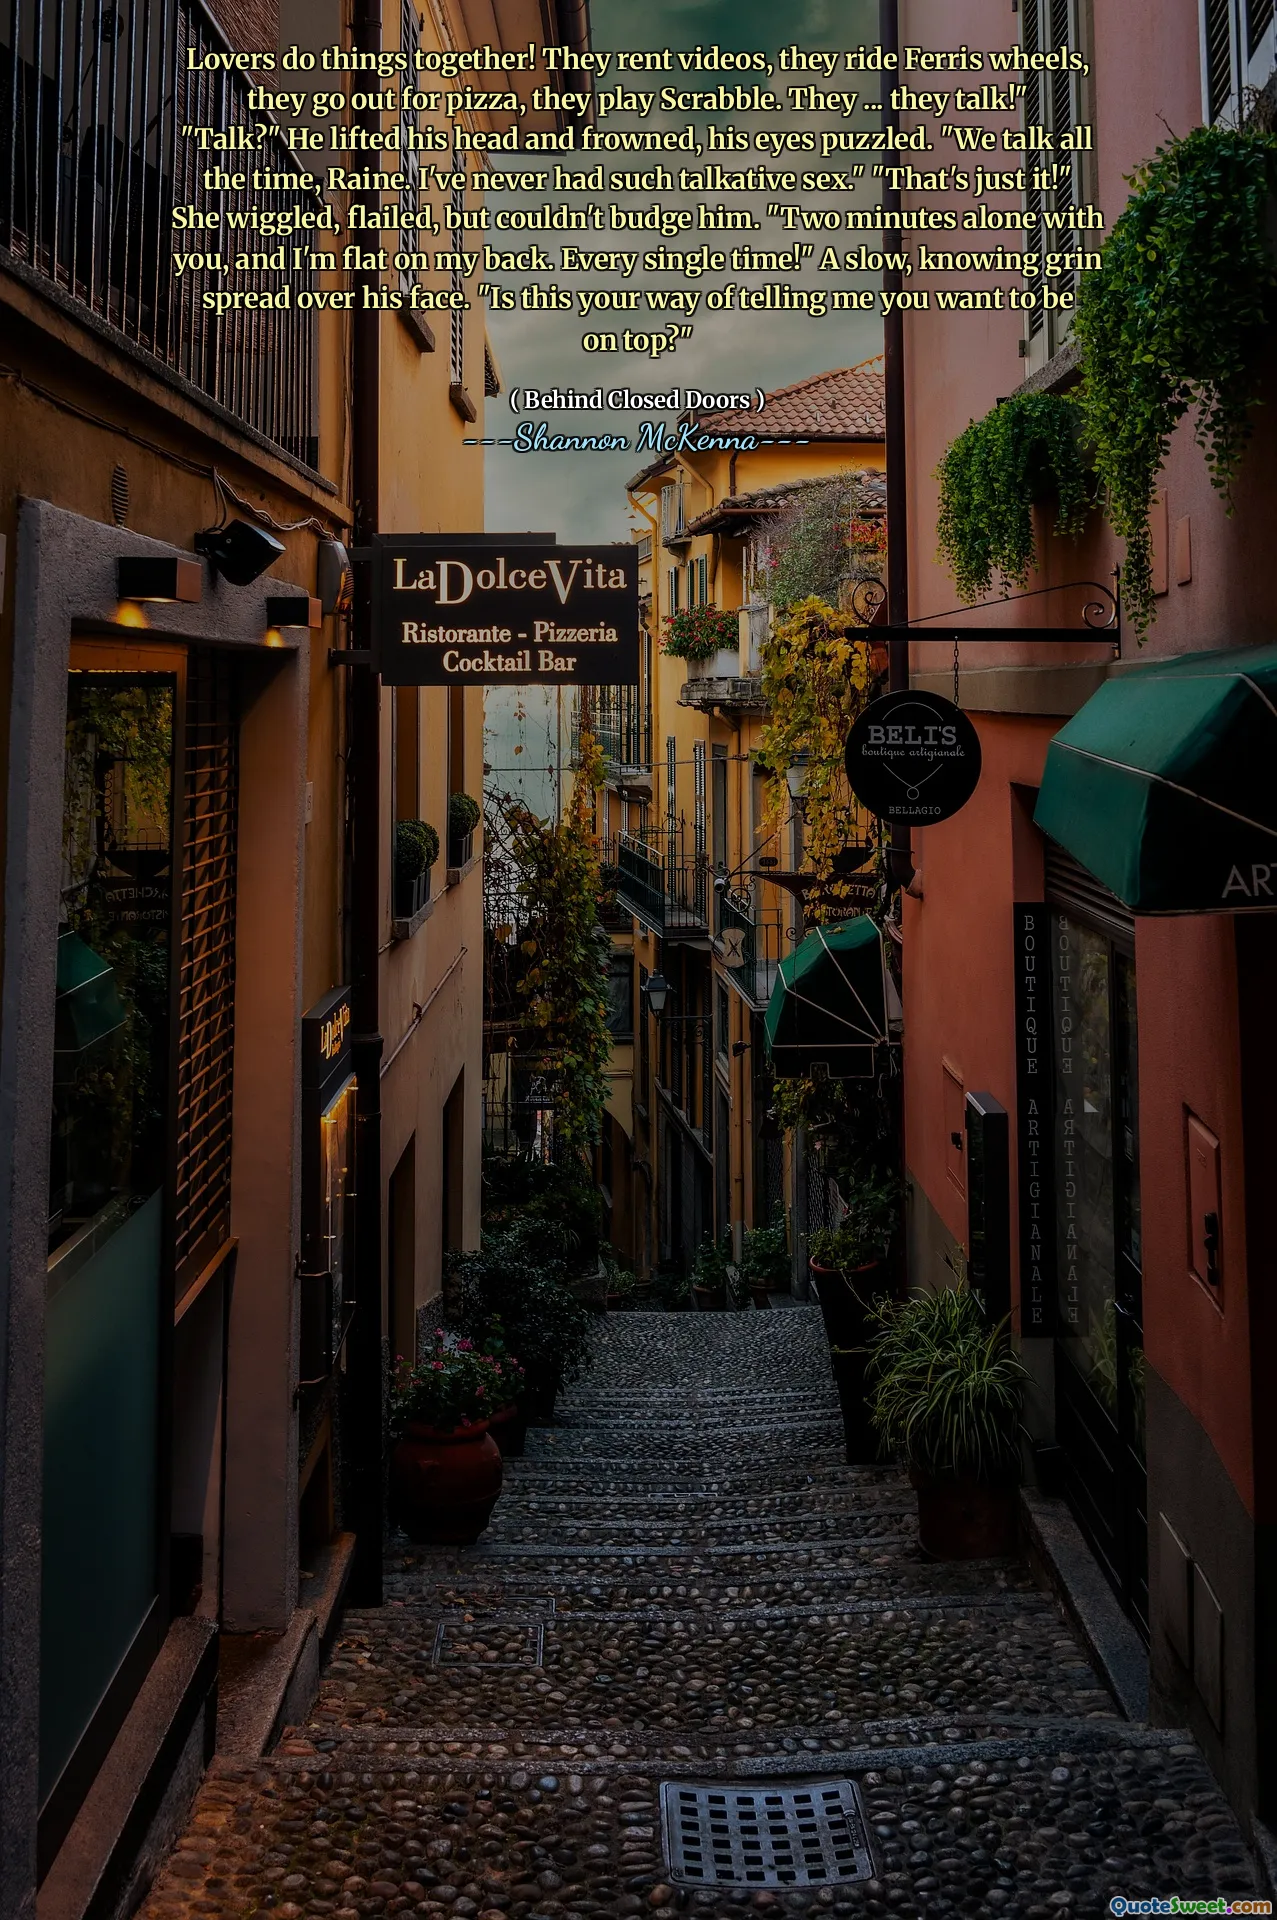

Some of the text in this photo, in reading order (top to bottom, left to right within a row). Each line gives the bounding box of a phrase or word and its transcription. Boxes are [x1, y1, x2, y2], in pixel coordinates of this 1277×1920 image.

[401, 621, 512, 644] Ristorante
[533, 621, 619, 643] Pizzeria
[442, 650, 577, 673] Cocktail Bar
[867, 725, 957, 746] BELI'S
[861, 744, 966, 762] boutique artigianale
[888, 806, 942, 816] BELLAGIO
[1024, 915, 1043, 1324] BOUTIQUE ARTIGIANALE
